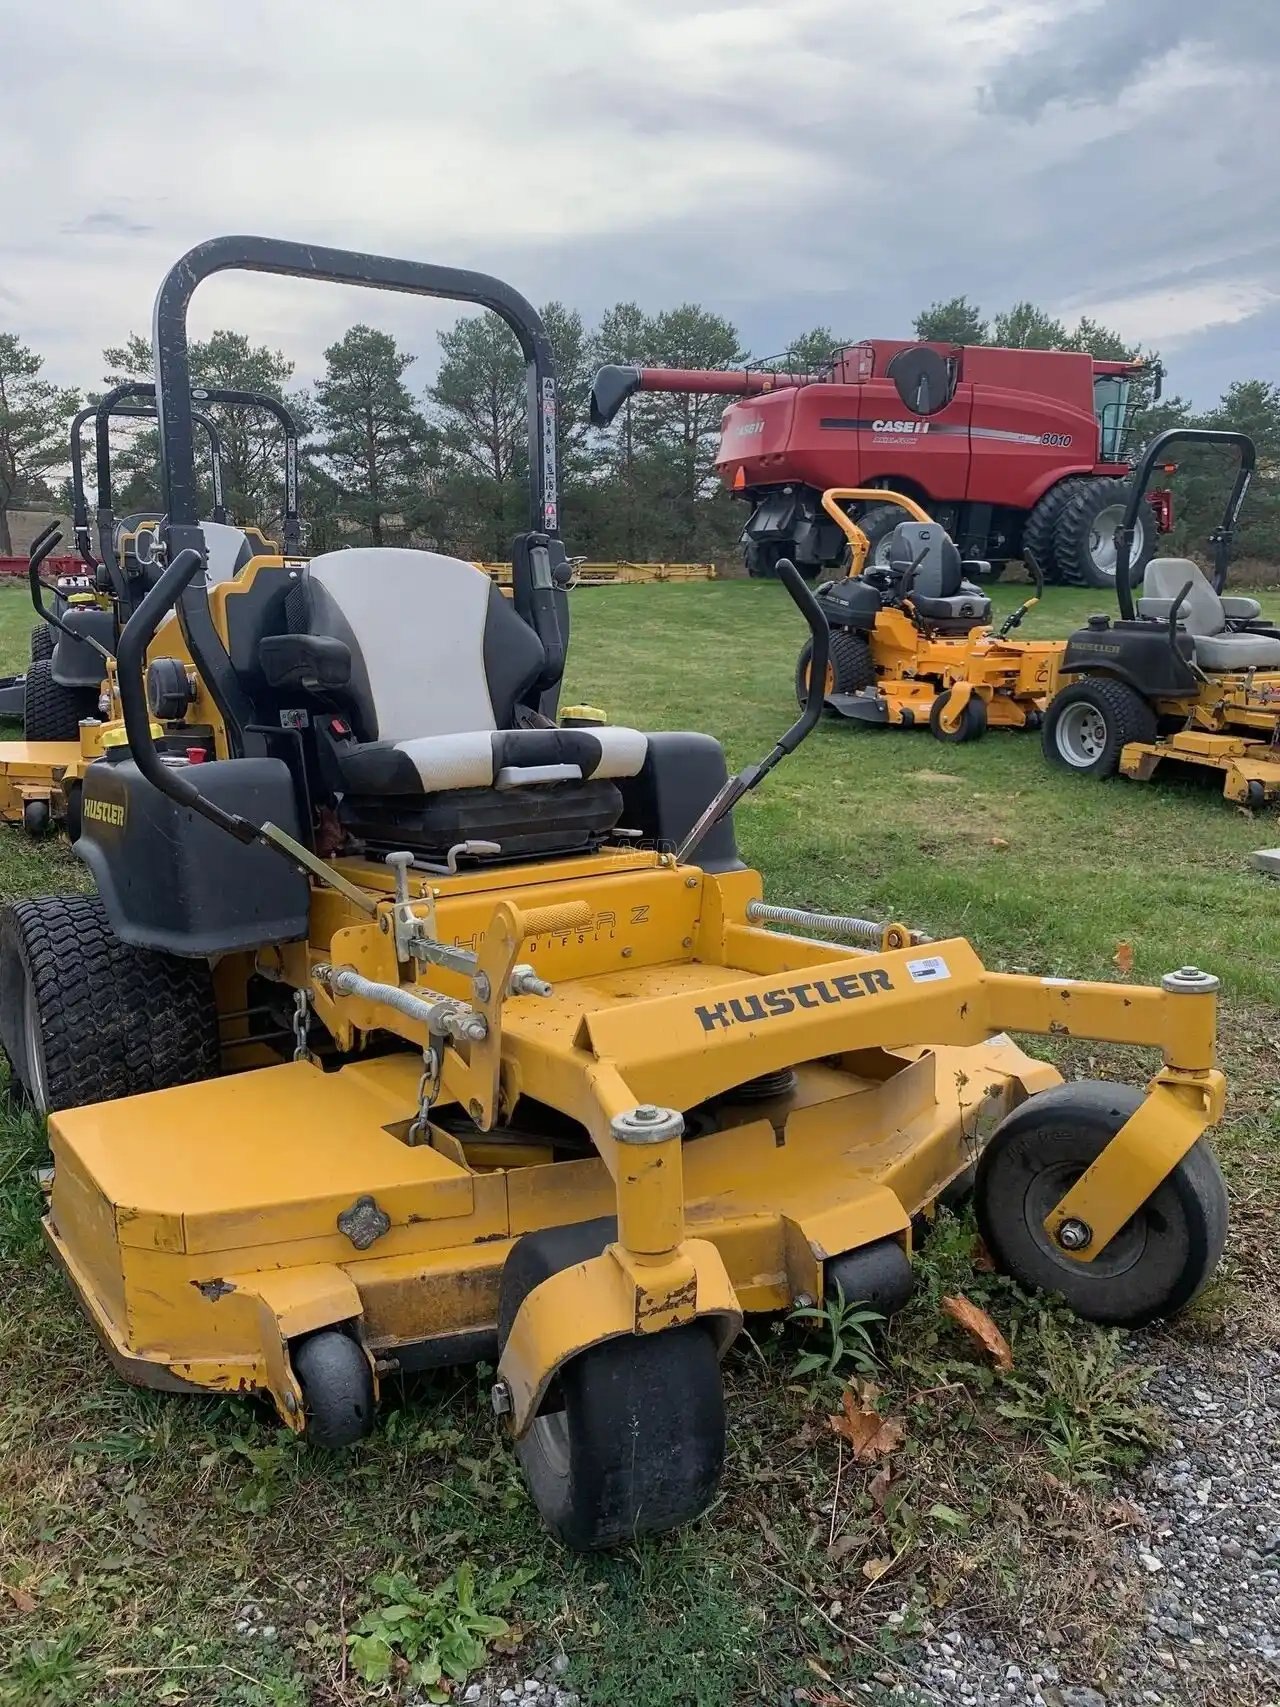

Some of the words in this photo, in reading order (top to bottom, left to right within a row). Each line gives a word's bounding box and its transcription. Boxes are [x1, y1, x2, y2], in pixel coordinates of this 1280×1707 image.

[1041, 432, 1072, 447] 8010
[84, 798, 125, 827] HUSTLER
[631, 905, 650, 924] Z
[694, 968, 895, 1031] HUSTLER
